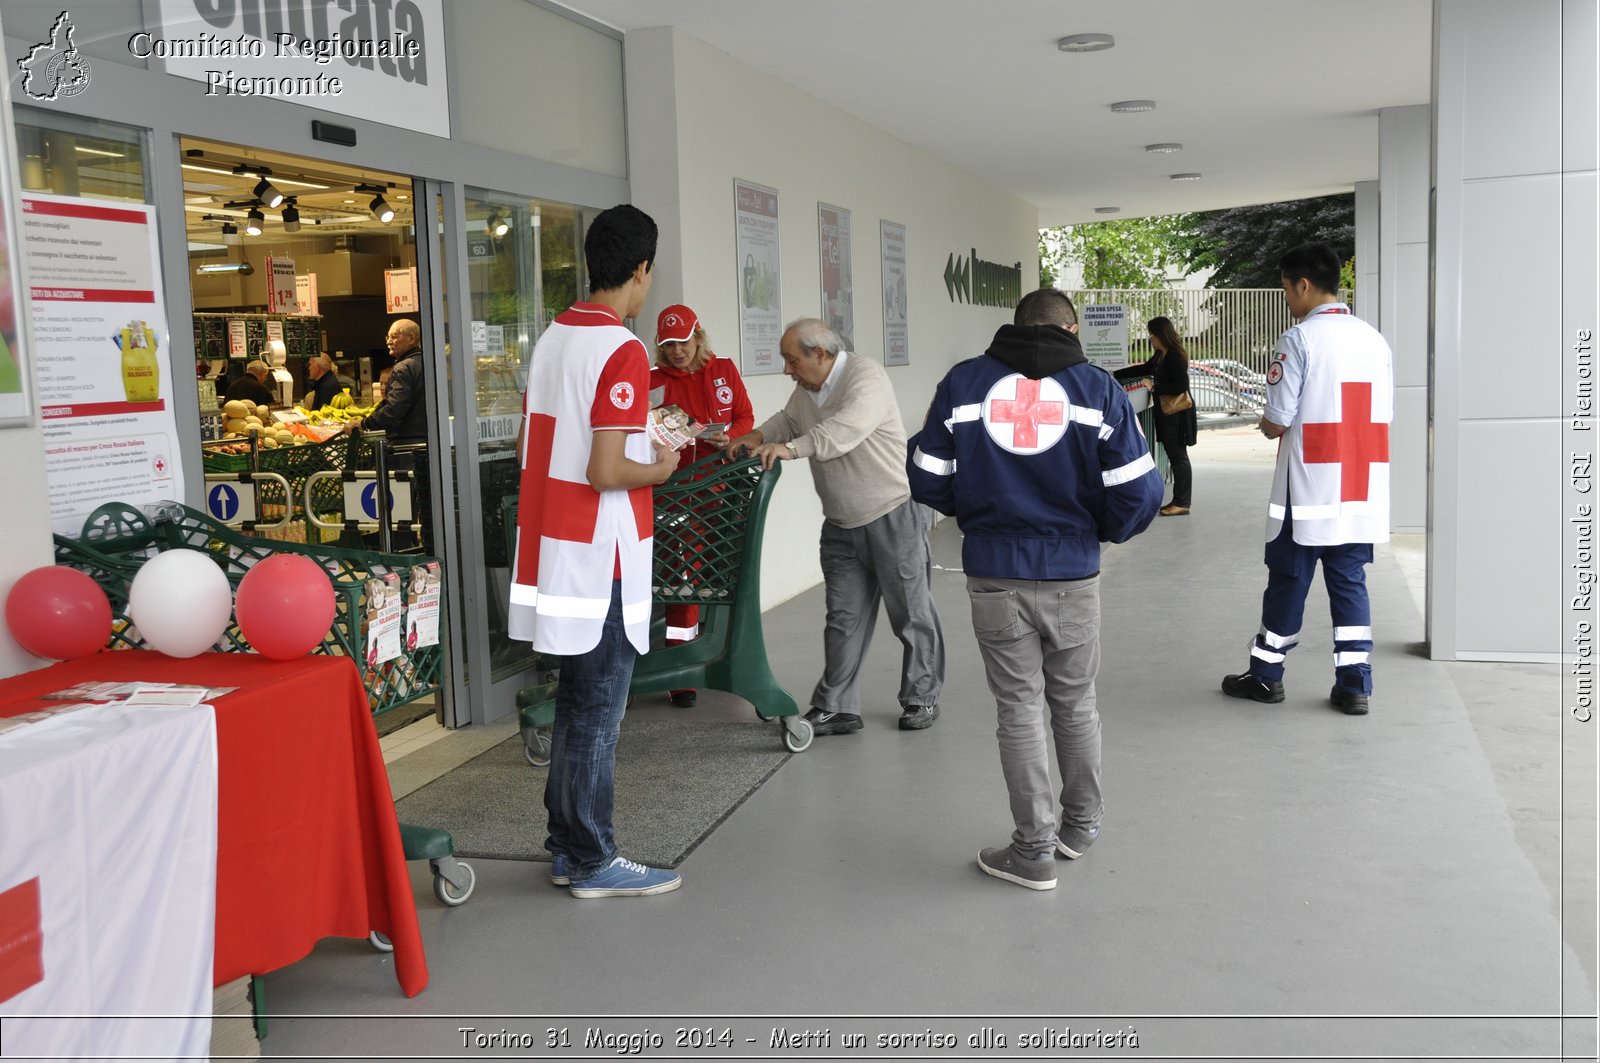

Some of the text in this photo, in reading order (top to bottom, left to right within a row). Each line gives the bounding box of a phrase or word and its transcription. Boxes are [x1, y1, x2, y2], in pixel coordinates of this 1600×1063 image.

[89, 444, 98, 452] per
[99, 442, 113, 450] Croce
[127, 439, 145, 447] Italiana
